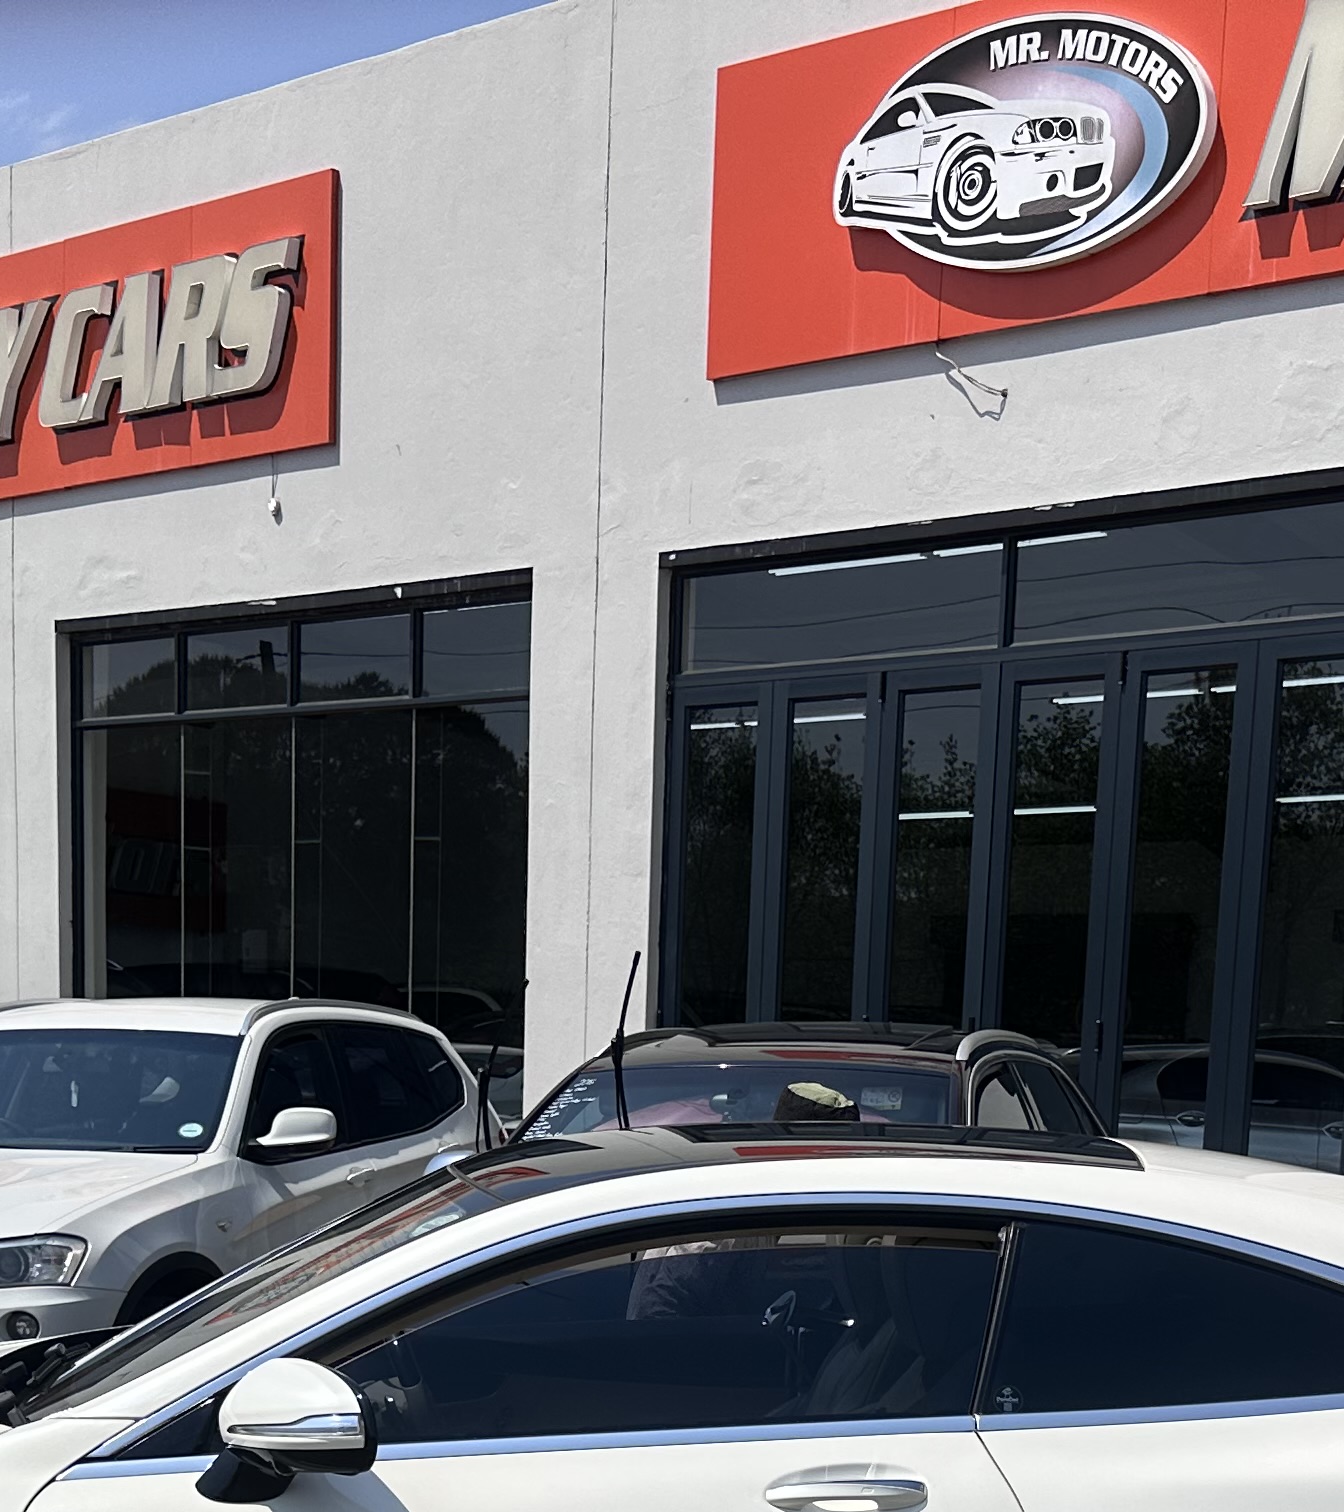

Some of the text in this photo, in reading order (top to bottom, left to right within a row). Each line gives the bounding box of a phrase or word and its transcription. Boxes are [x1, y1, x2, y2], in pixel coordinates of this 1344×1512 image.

[989, 28, 1184, 104] MR. MOTORS
[38, 236, 304, 428] CARS
